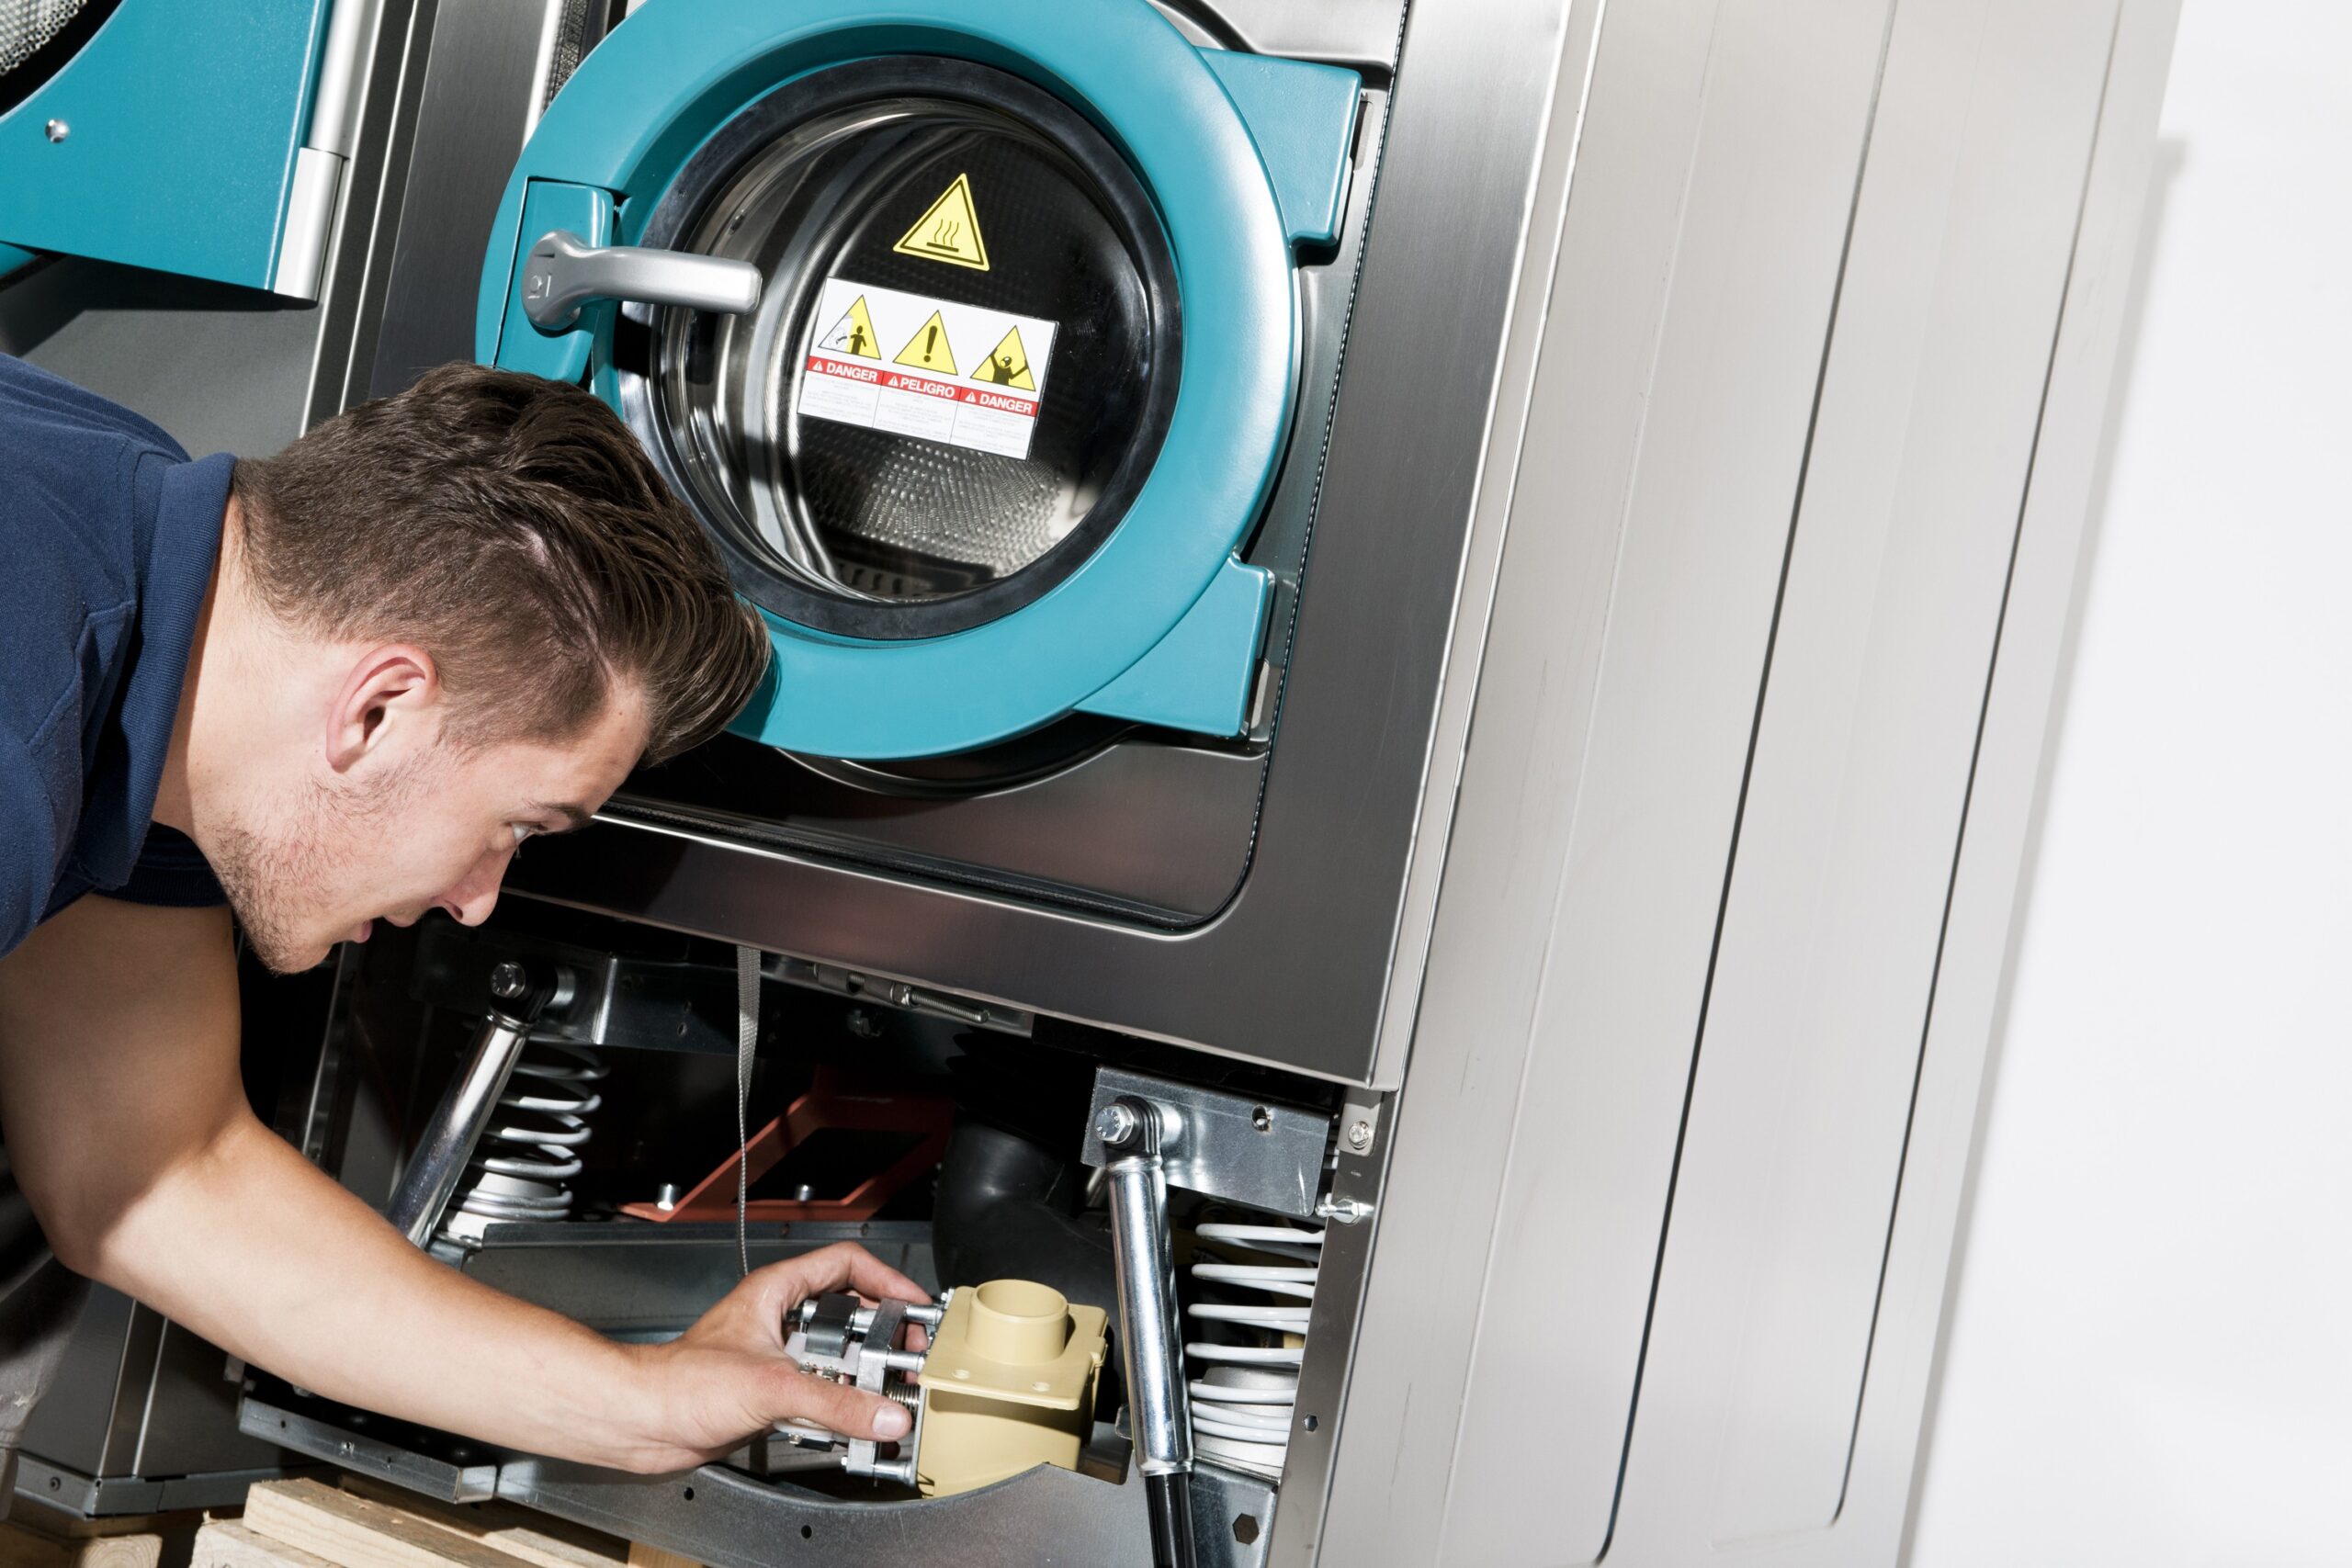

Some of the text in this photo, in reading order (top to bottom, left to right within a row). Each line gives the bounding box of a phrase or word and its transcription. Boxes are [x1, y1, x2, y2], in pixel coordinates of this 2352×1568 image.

[826, 362, 877, 382] DANGER
[899, 377, 956, 398] PELIGRO
[979, 393, 1033, 414] DANGER
